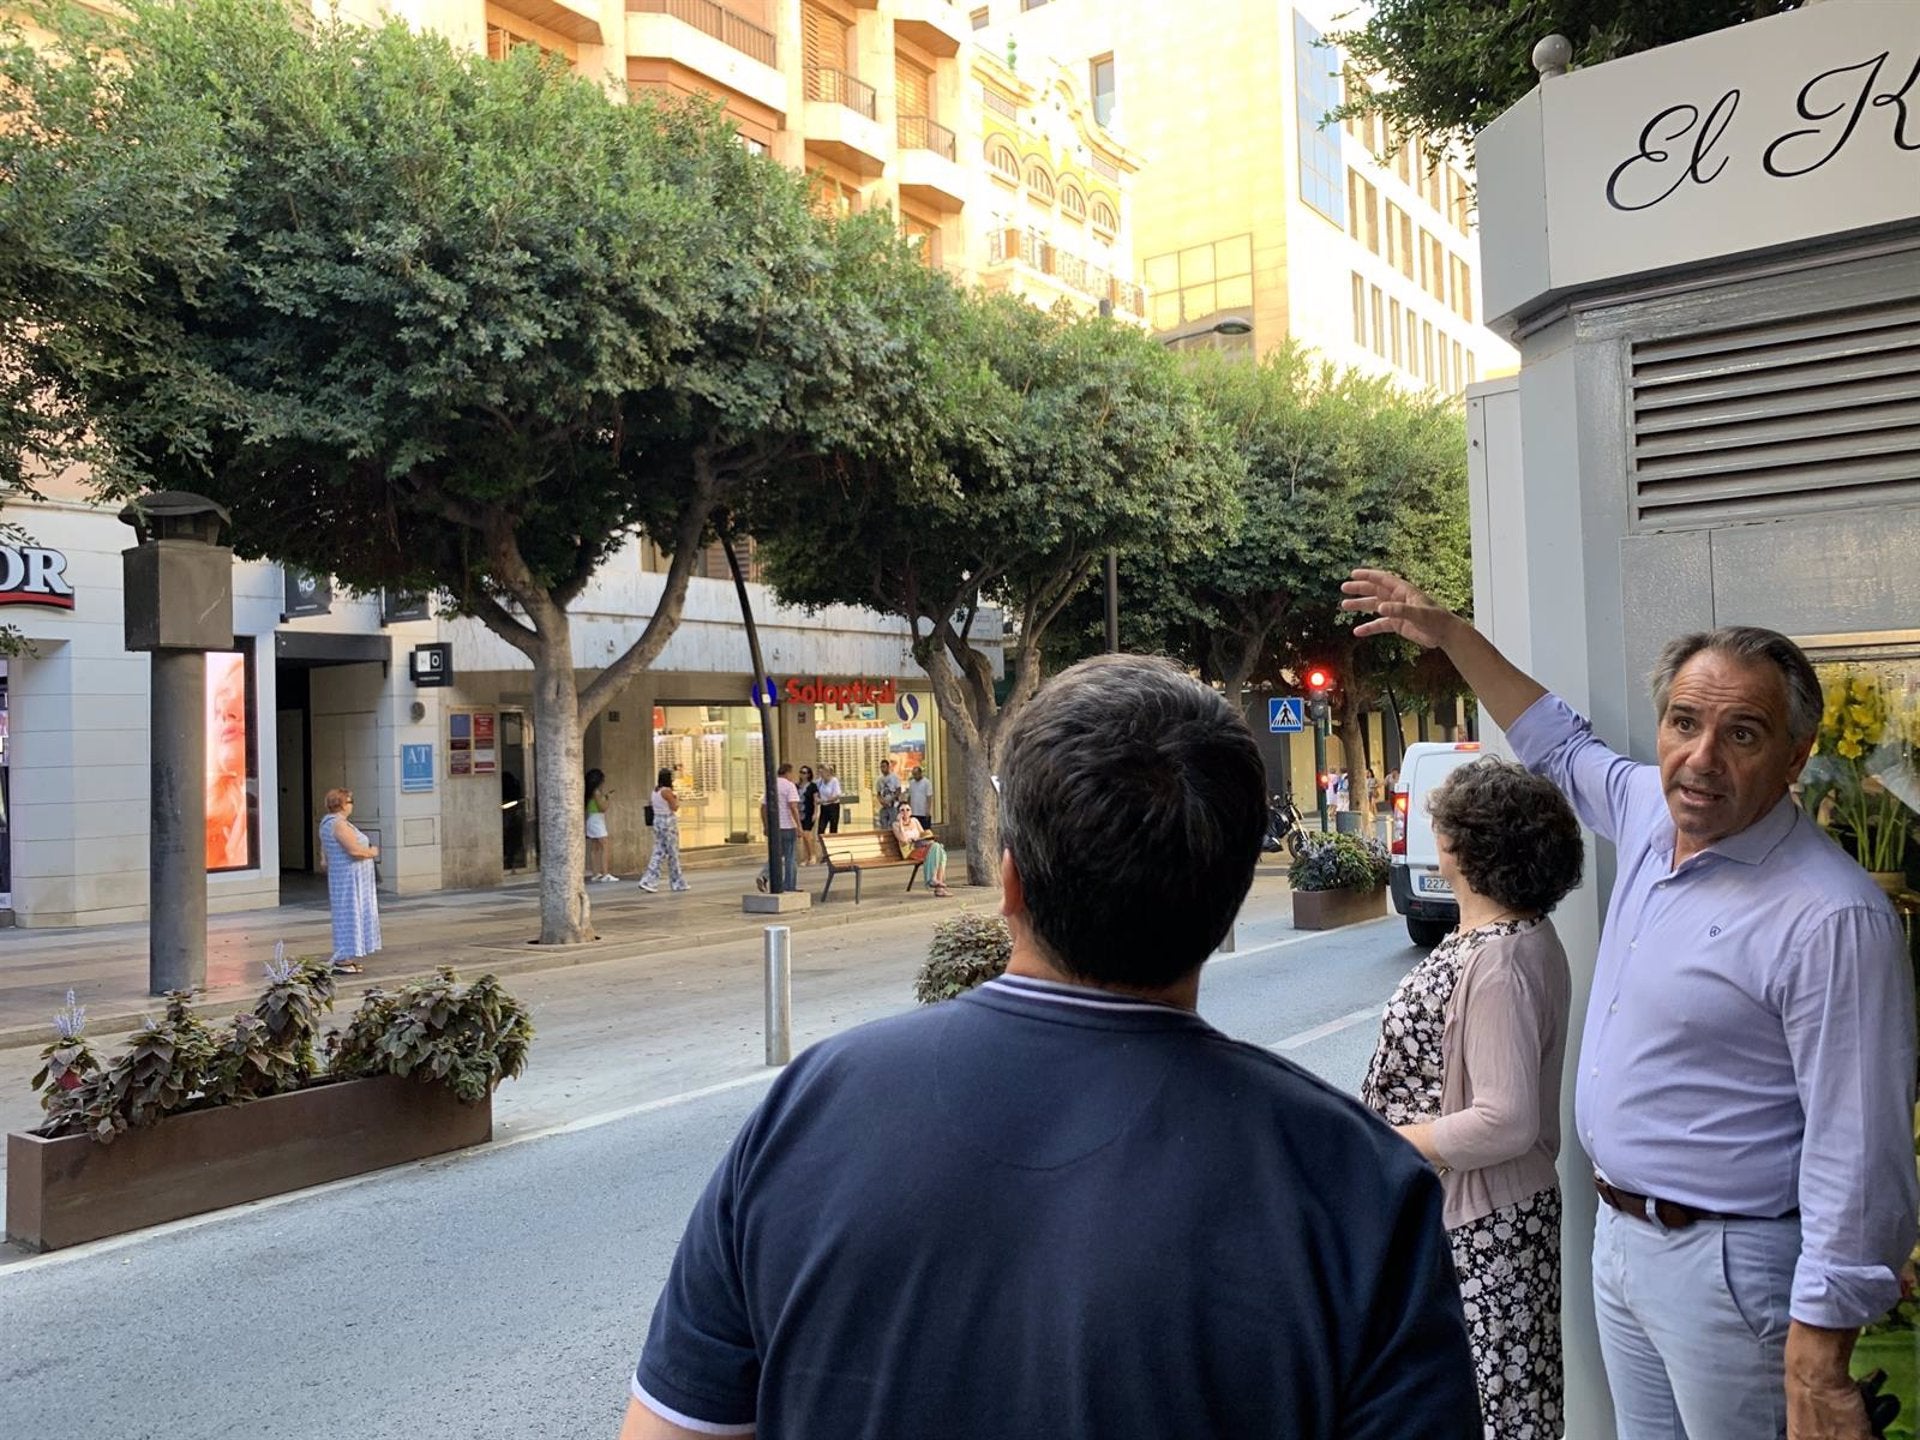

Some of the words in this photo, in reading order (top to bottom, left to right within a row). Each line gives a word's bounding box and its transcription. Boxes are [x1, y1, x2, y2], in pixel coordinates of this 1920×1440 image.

[1606, 89, 1741, 211] El
[785, 675, 896, 711] Soloptical
[408, 747, 429, 764] AT
